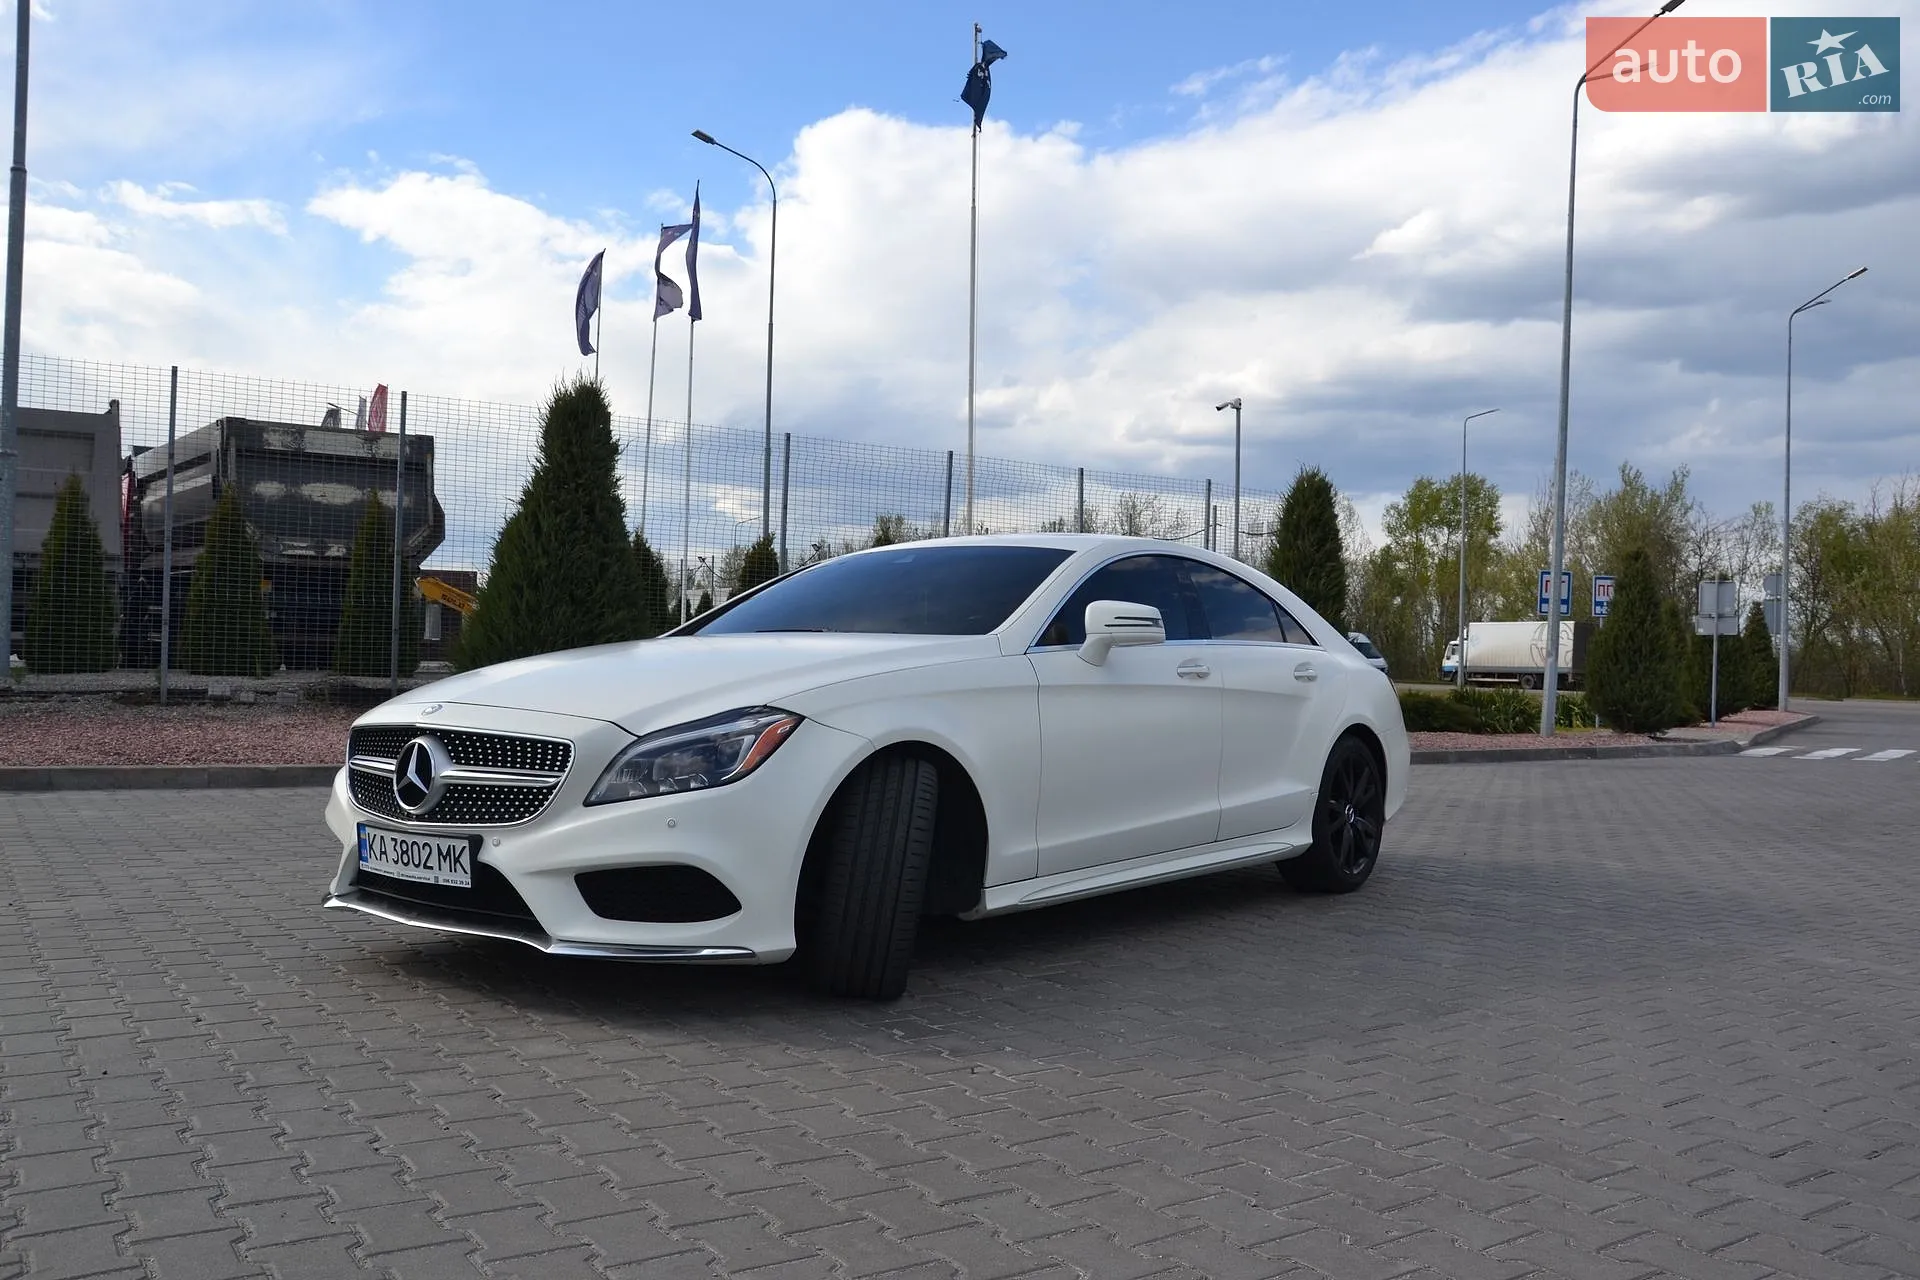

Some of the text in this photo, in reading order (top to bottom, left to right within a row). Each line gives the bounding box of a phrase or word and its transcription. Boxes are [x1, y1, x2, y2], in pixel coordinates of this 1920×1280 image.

[368, 832, 468, 875] KA 3802 MK
